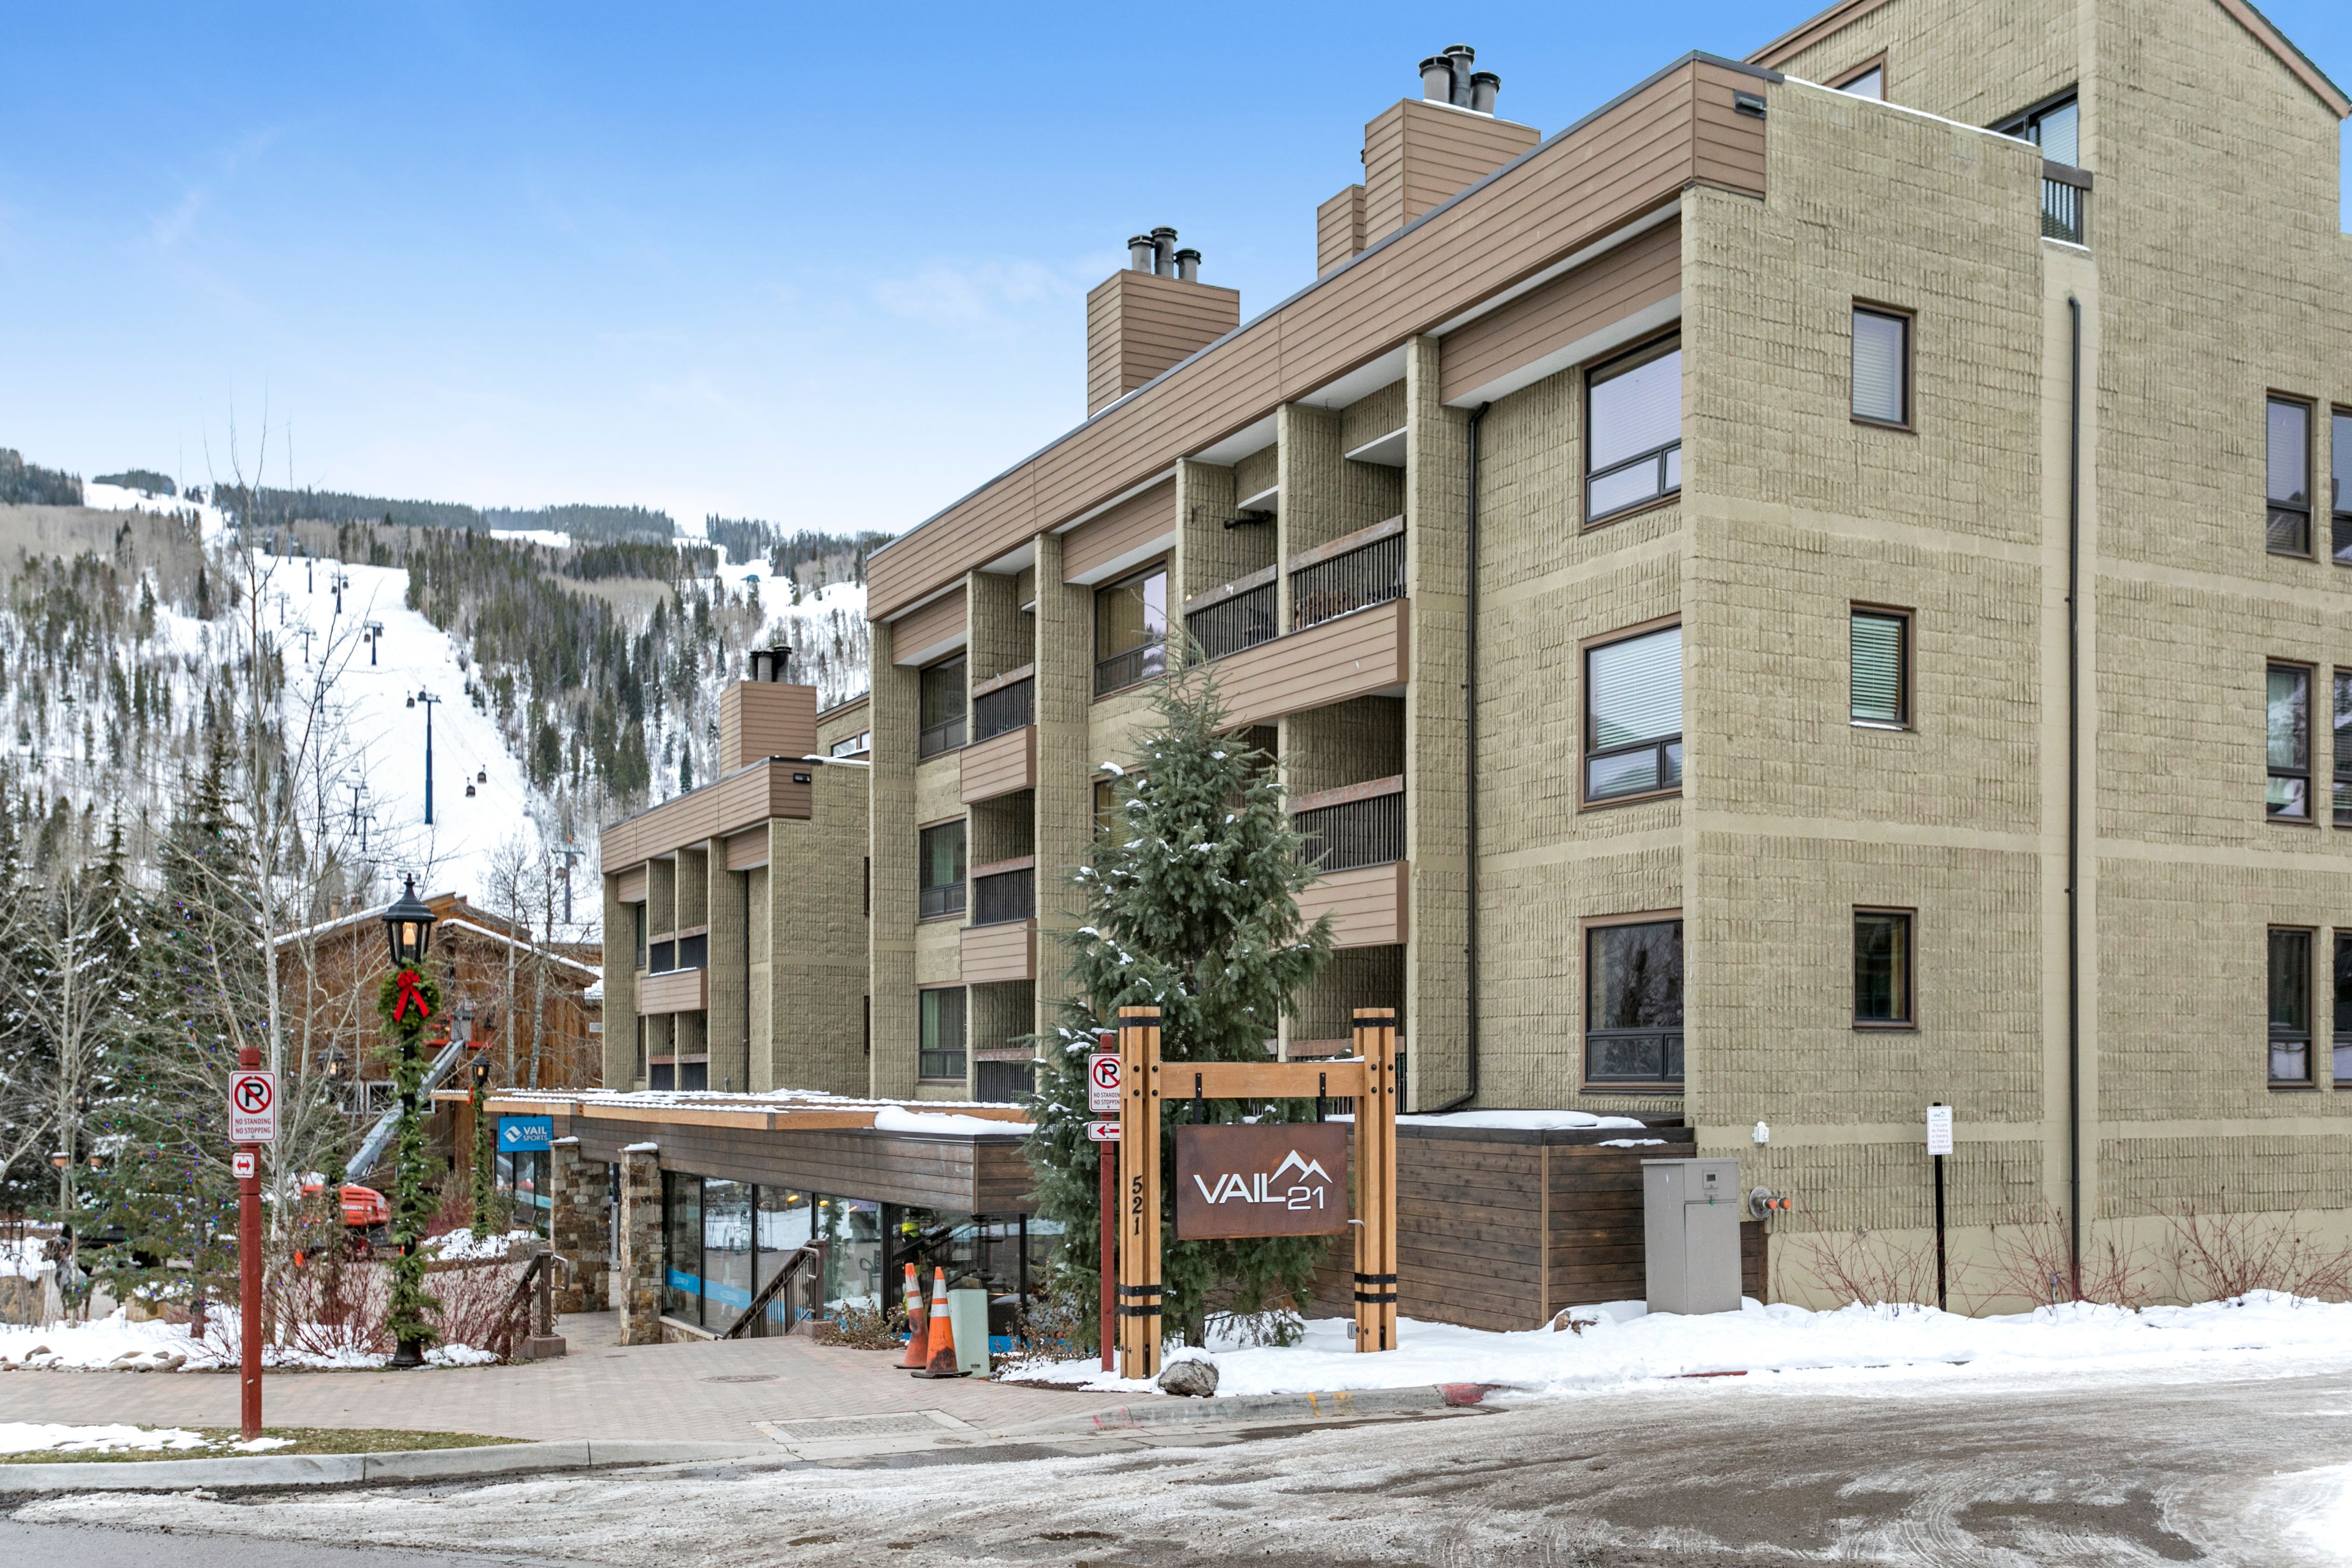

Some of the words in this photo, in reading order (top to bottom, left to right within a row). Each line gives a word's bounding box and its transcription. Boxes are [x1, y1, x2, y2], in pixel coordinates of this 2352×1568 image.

[245, 1083, 264, 1107] P
[523, 1126, 547, 1135] VAIL
[1132, 1175, 1142, 1235] 521
[1193, 1173, 1286, 1204] VAIL
[1288, 1186, 1323, 1210] 21
